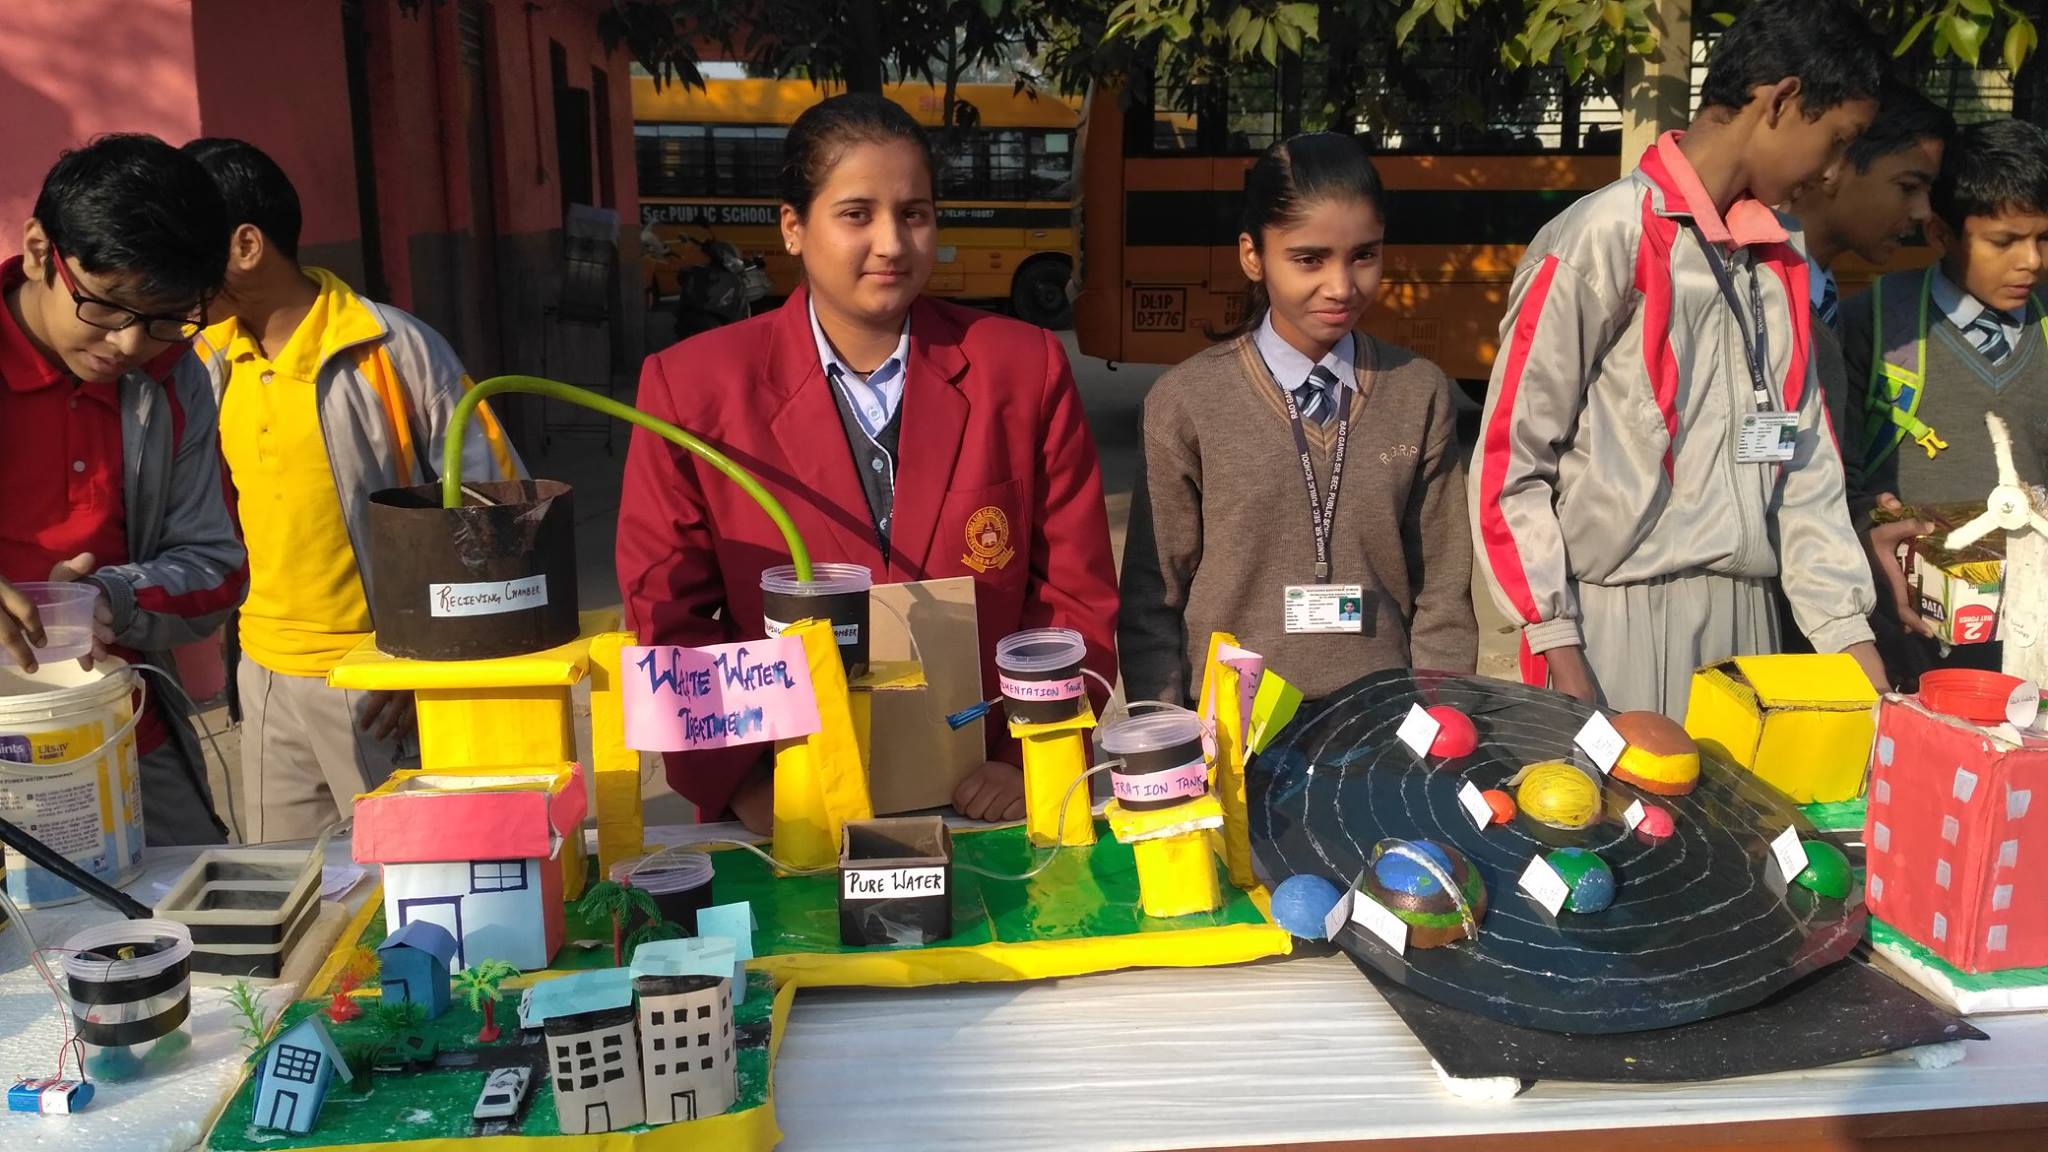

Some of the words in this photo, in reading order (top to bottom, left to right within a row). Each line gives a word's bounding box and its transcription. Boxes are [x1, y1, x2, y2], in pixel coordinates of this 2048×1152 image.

[721, 206, 777, 223] SCHOOL
[1301, 451, 1314, 481] SCHOOL
[1308, 481, 1319, 507] PUBLIC
[1323, 492, 1336, 518] PUBLIC
[505, 582, 540, 600] CHAMBER
[1964, 622, 1984, 641] 2
[713, 647, 796, 691] WATER
[0, 742, 24, 755] ints
[1114, 782, 1169, 797] TRATION
[1176, 775, 1202, 790] TANK
[846, 872, 884, 893] PURE
[892, 870, 942, 890] WATER
